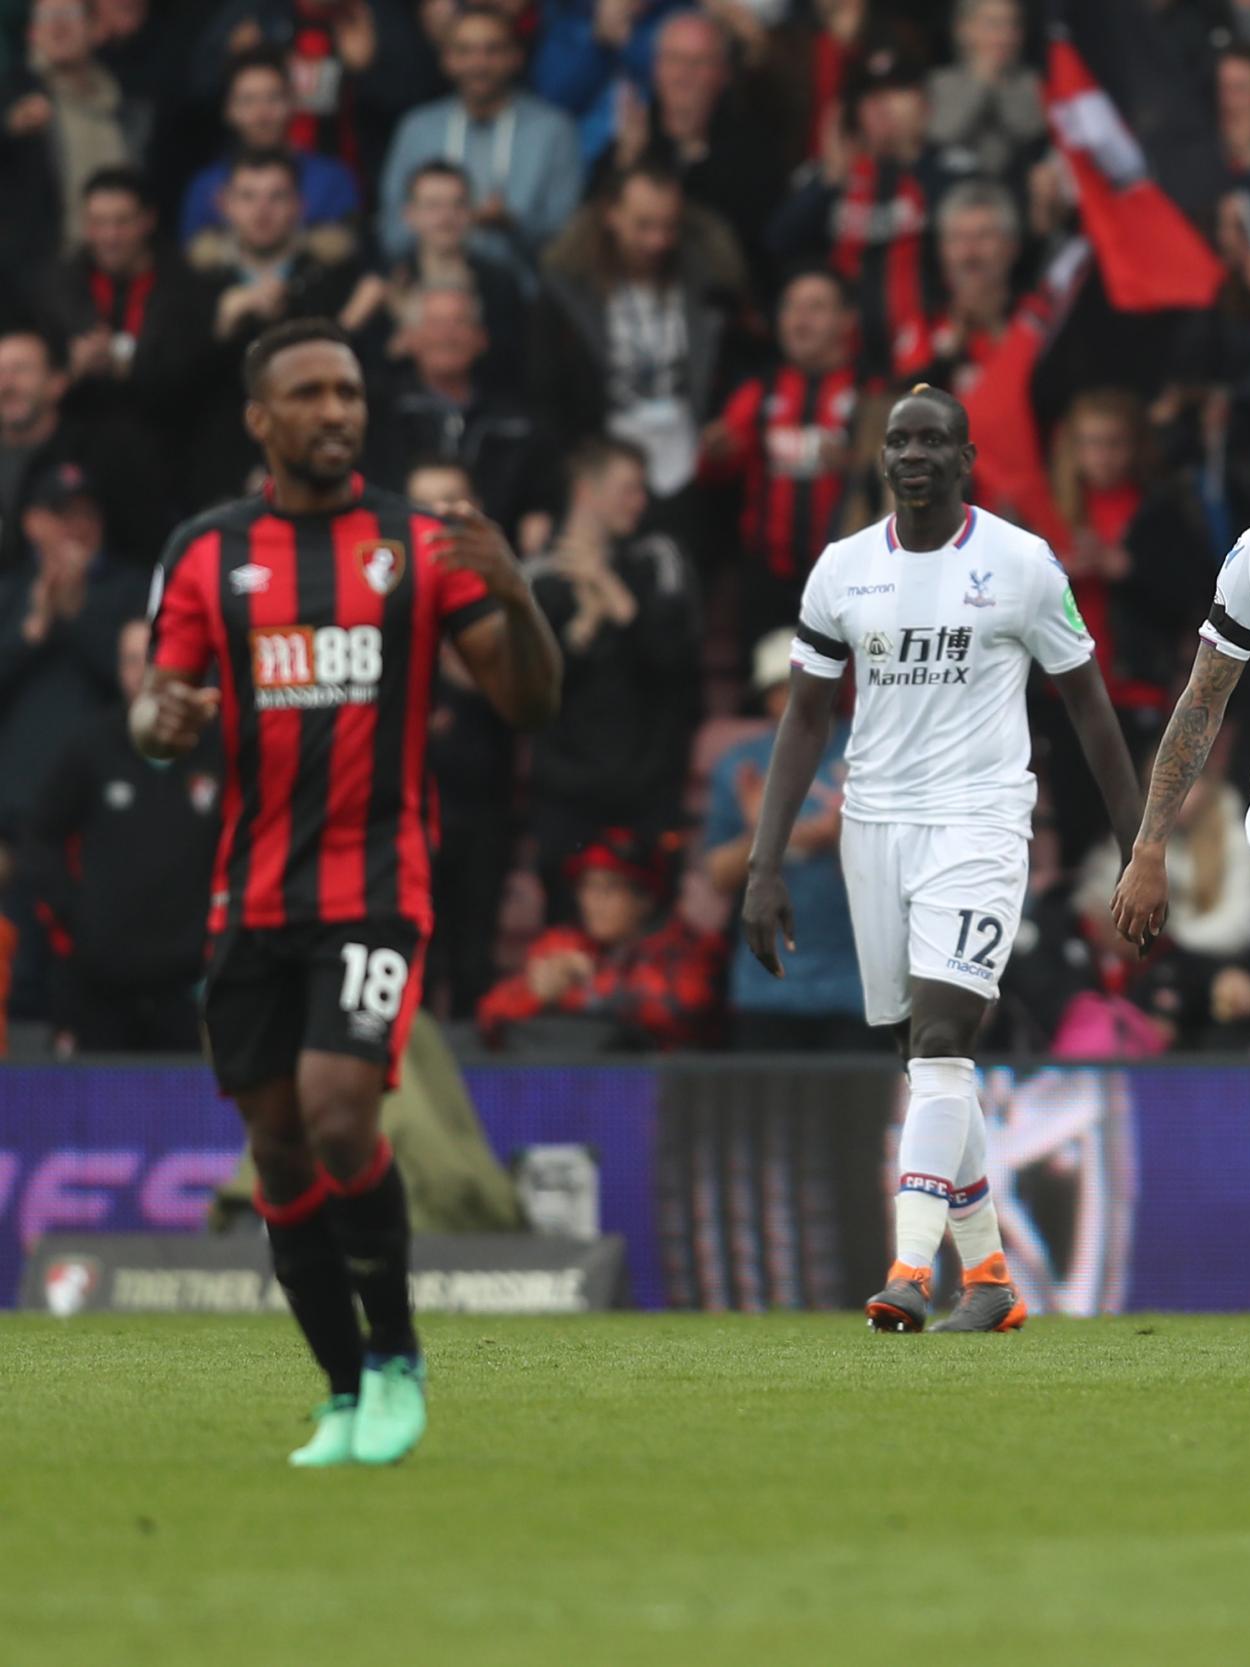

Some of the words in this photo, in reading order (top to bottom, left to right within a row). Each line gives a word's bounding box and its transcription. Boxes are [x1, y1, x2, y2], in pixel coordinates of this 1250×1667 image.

[848, 583, 896, 596] macron
[897, 625, 973, 663] 万博
[868, 666, 970, 687] ManBetX
[954, 909, 1003, 970] 12
[339, 942, 408, 1022] 18
[905, 1176, 948, 1197] CPFC
